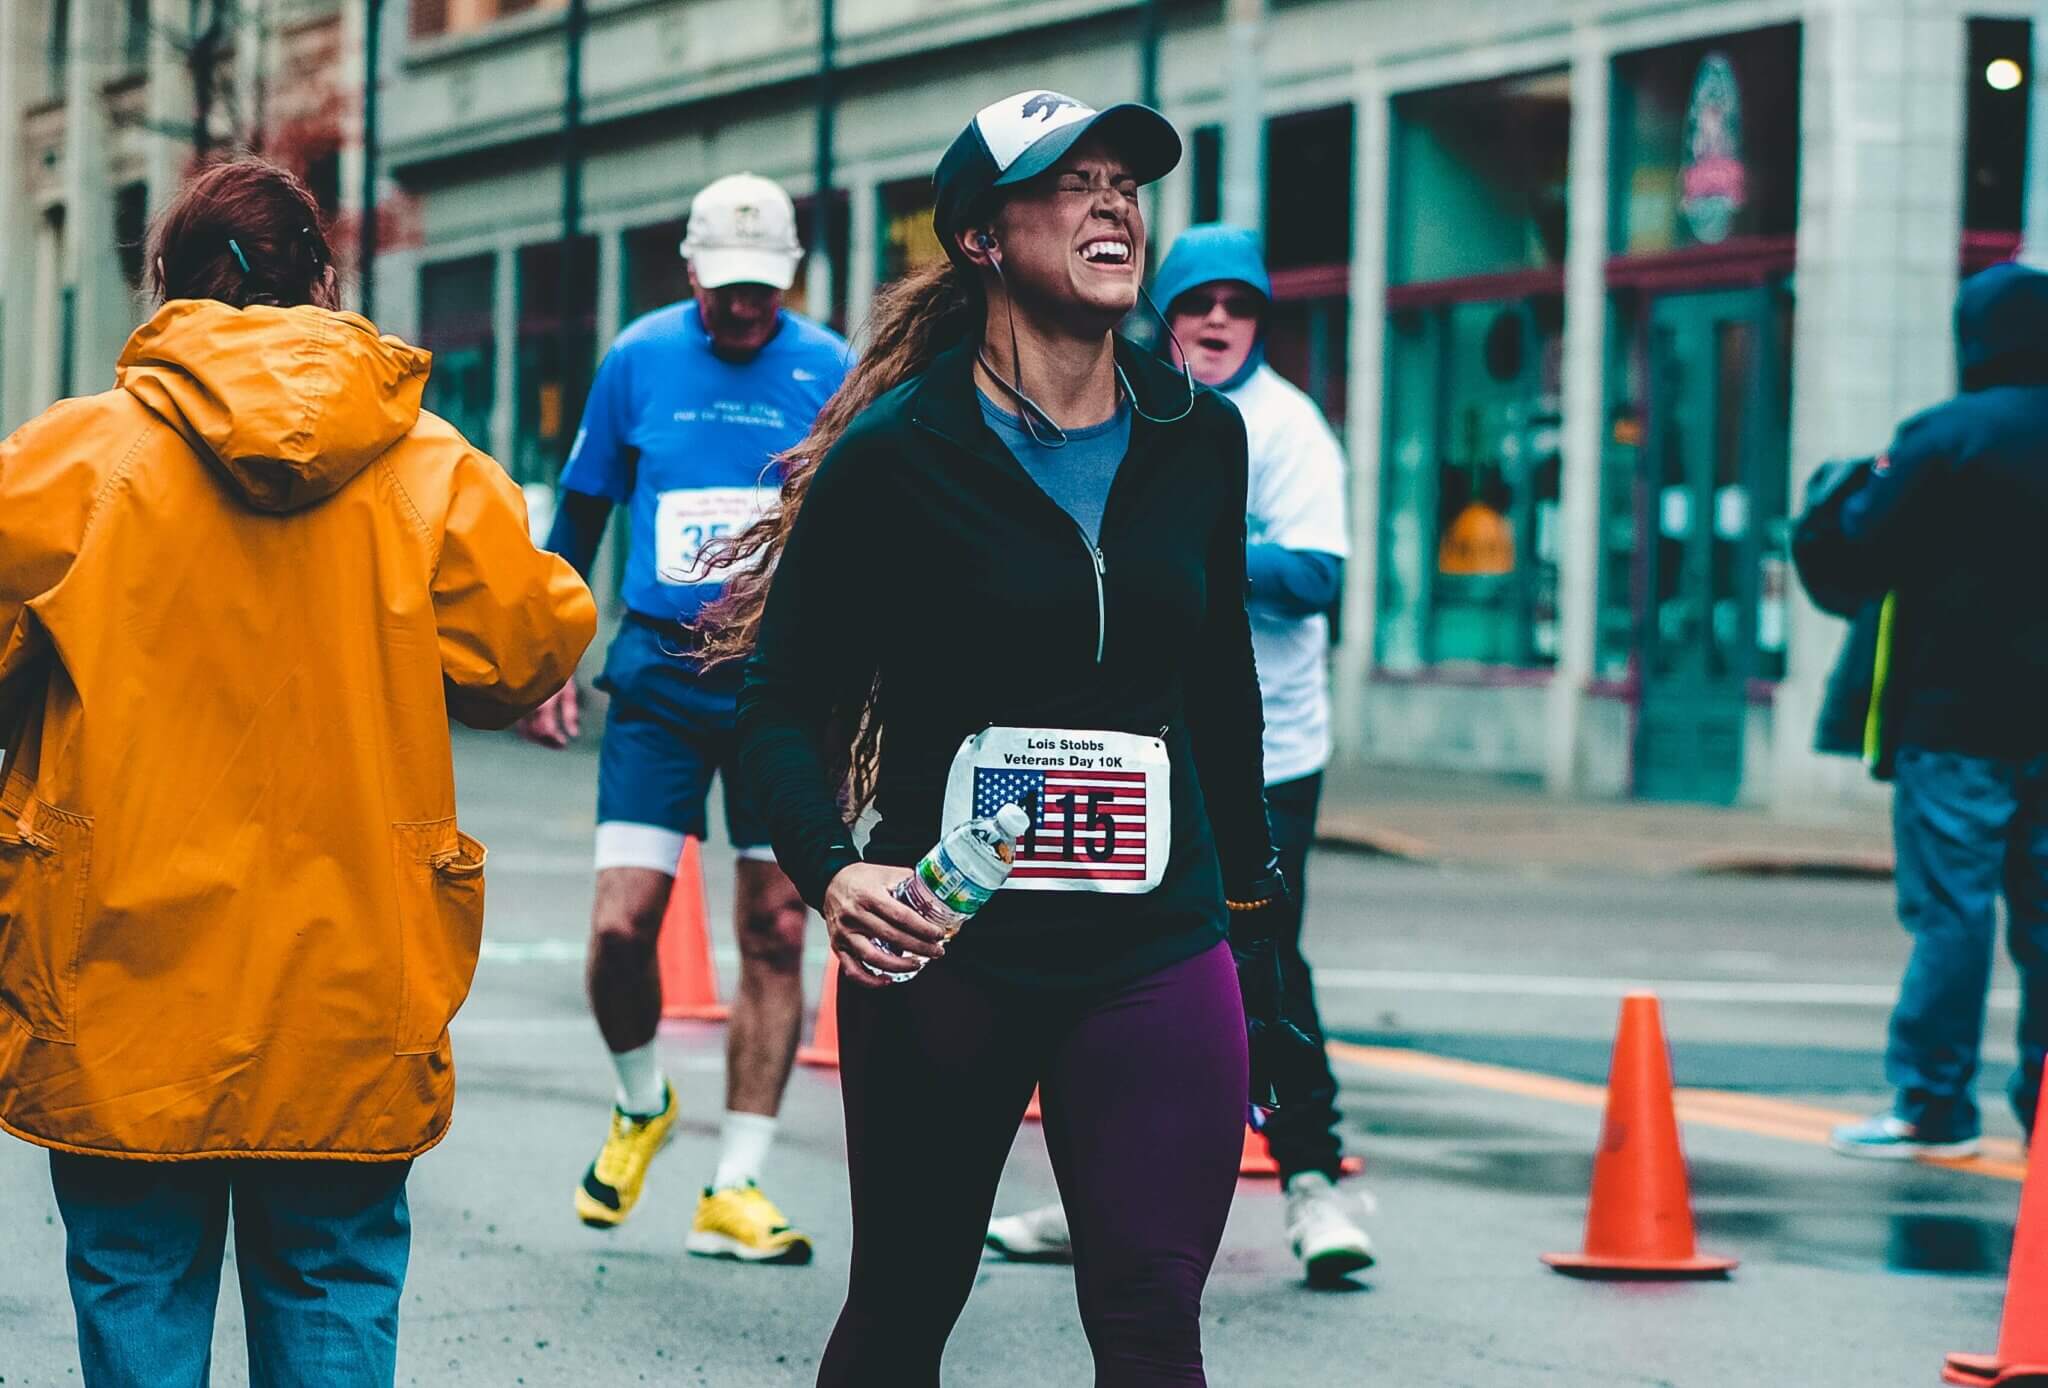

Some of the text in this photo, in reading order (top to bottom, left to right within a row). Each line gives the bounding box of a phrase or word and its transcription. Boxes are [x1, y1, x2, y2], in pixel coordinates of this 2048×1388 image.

[1027, 738, 1104, 751] Lois Stobbs
[1004, 753, 1123, 768] Veterans Day 10K
[1019, 791, 1115, 863] 115
